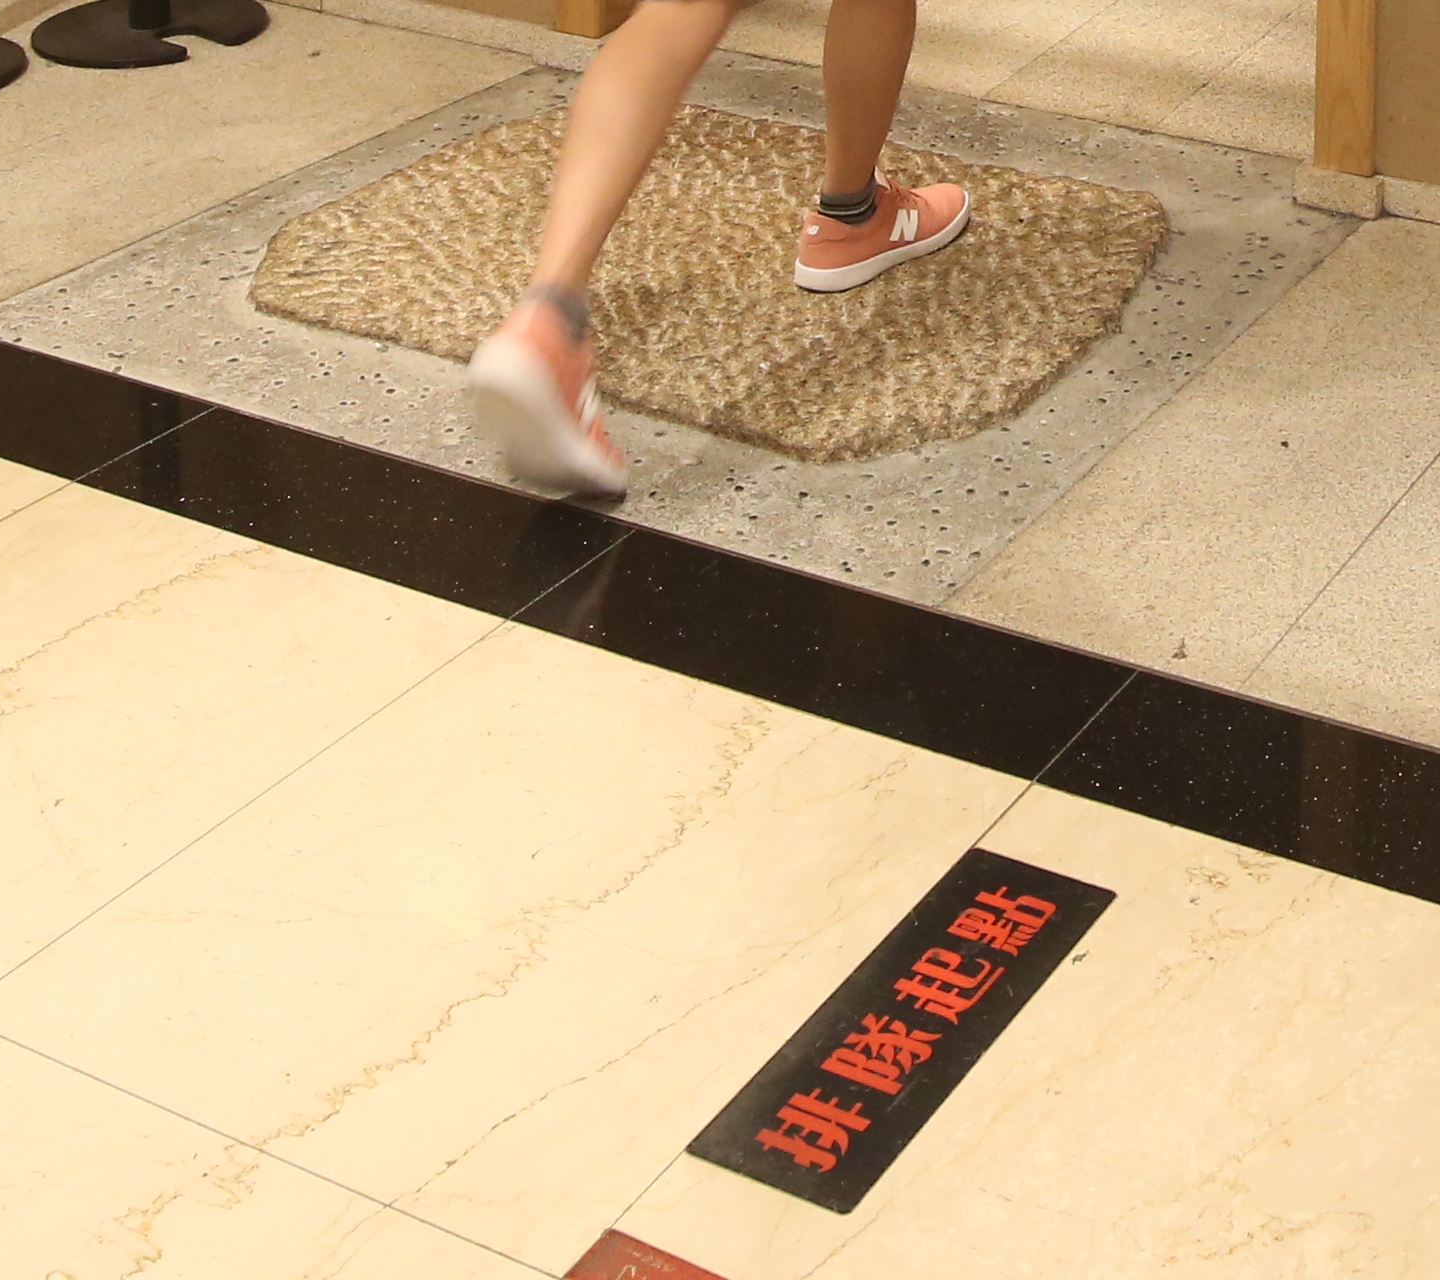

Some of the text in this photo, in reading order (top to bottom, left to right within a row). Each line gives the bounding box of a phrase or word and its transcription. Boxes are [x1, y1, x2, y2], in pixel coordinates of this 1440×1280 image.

[889, 208, 919, 242] N
[754, 885, 1059, 1175] 排隊起點
